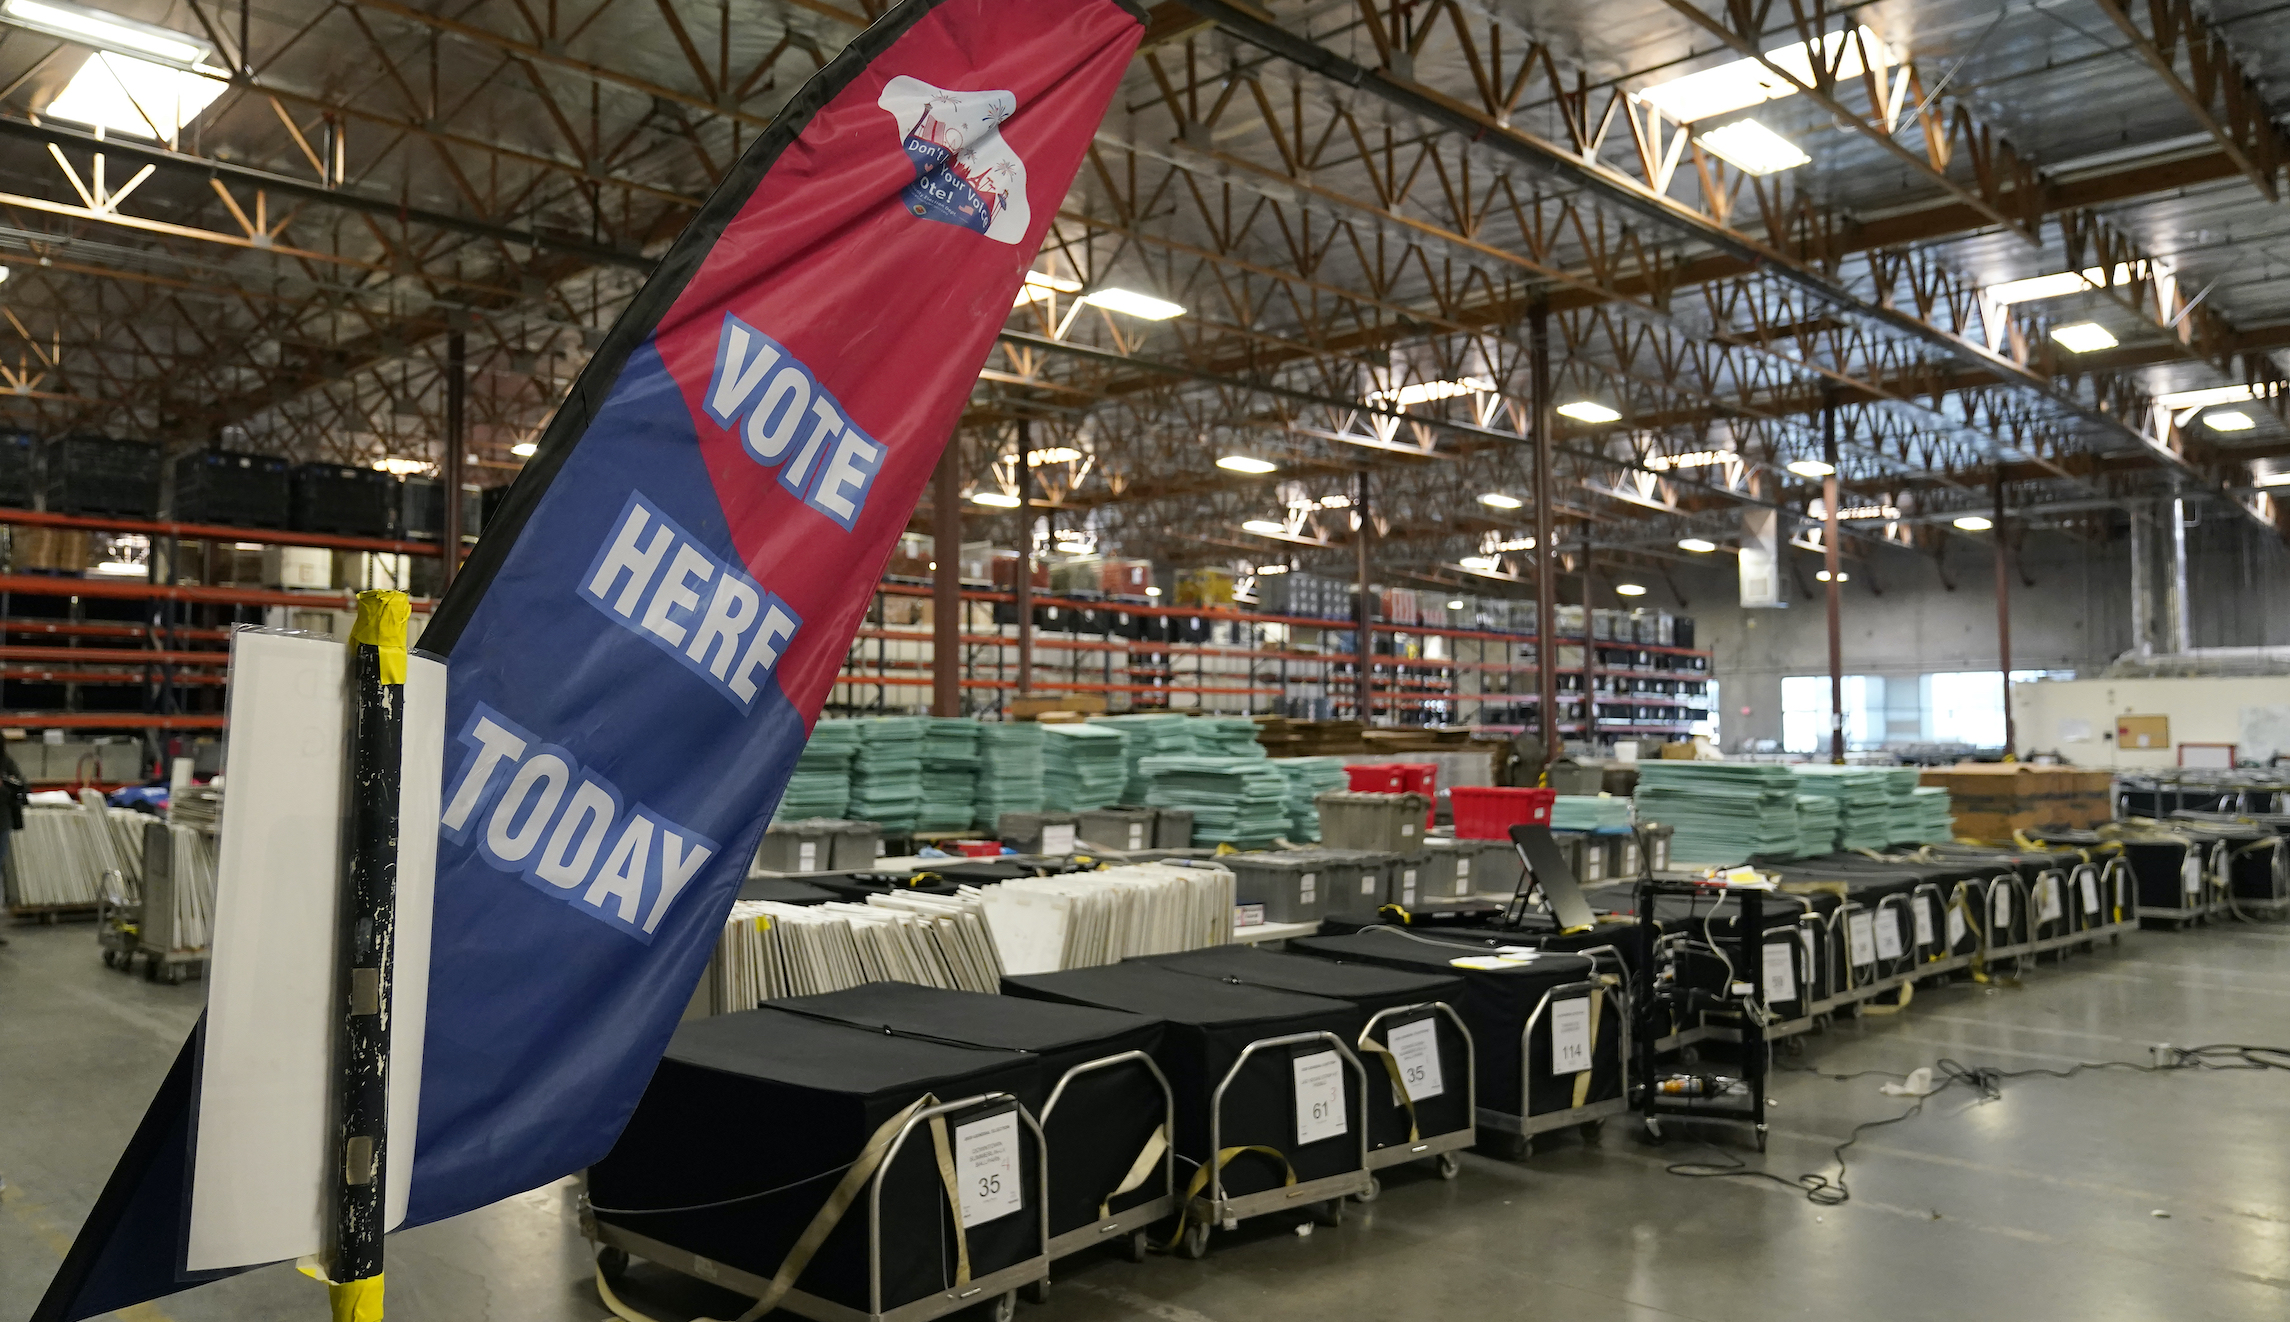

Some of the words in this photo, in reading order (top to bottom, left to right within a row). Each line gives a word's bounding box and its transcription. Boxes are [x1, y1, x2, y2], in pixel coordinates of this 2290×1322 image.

[908, 139, 944, 161] Don't
[940, 162, 966, 191] Your
[967, 187, 989, 228] Voice
[920, 176, 954, 203] ote!
[709, 324, 878, 521] VOTE
[588, 502, 797, 705] HERE
[441, 715, 713, 935] TODAY
[1563, 1044, 1581, 1059] 114
[1407, 1065, 1424, 1083] 35
[1313, 1100, 1328, 1119] 61
[978, 1173, 1001, 1197] 35
